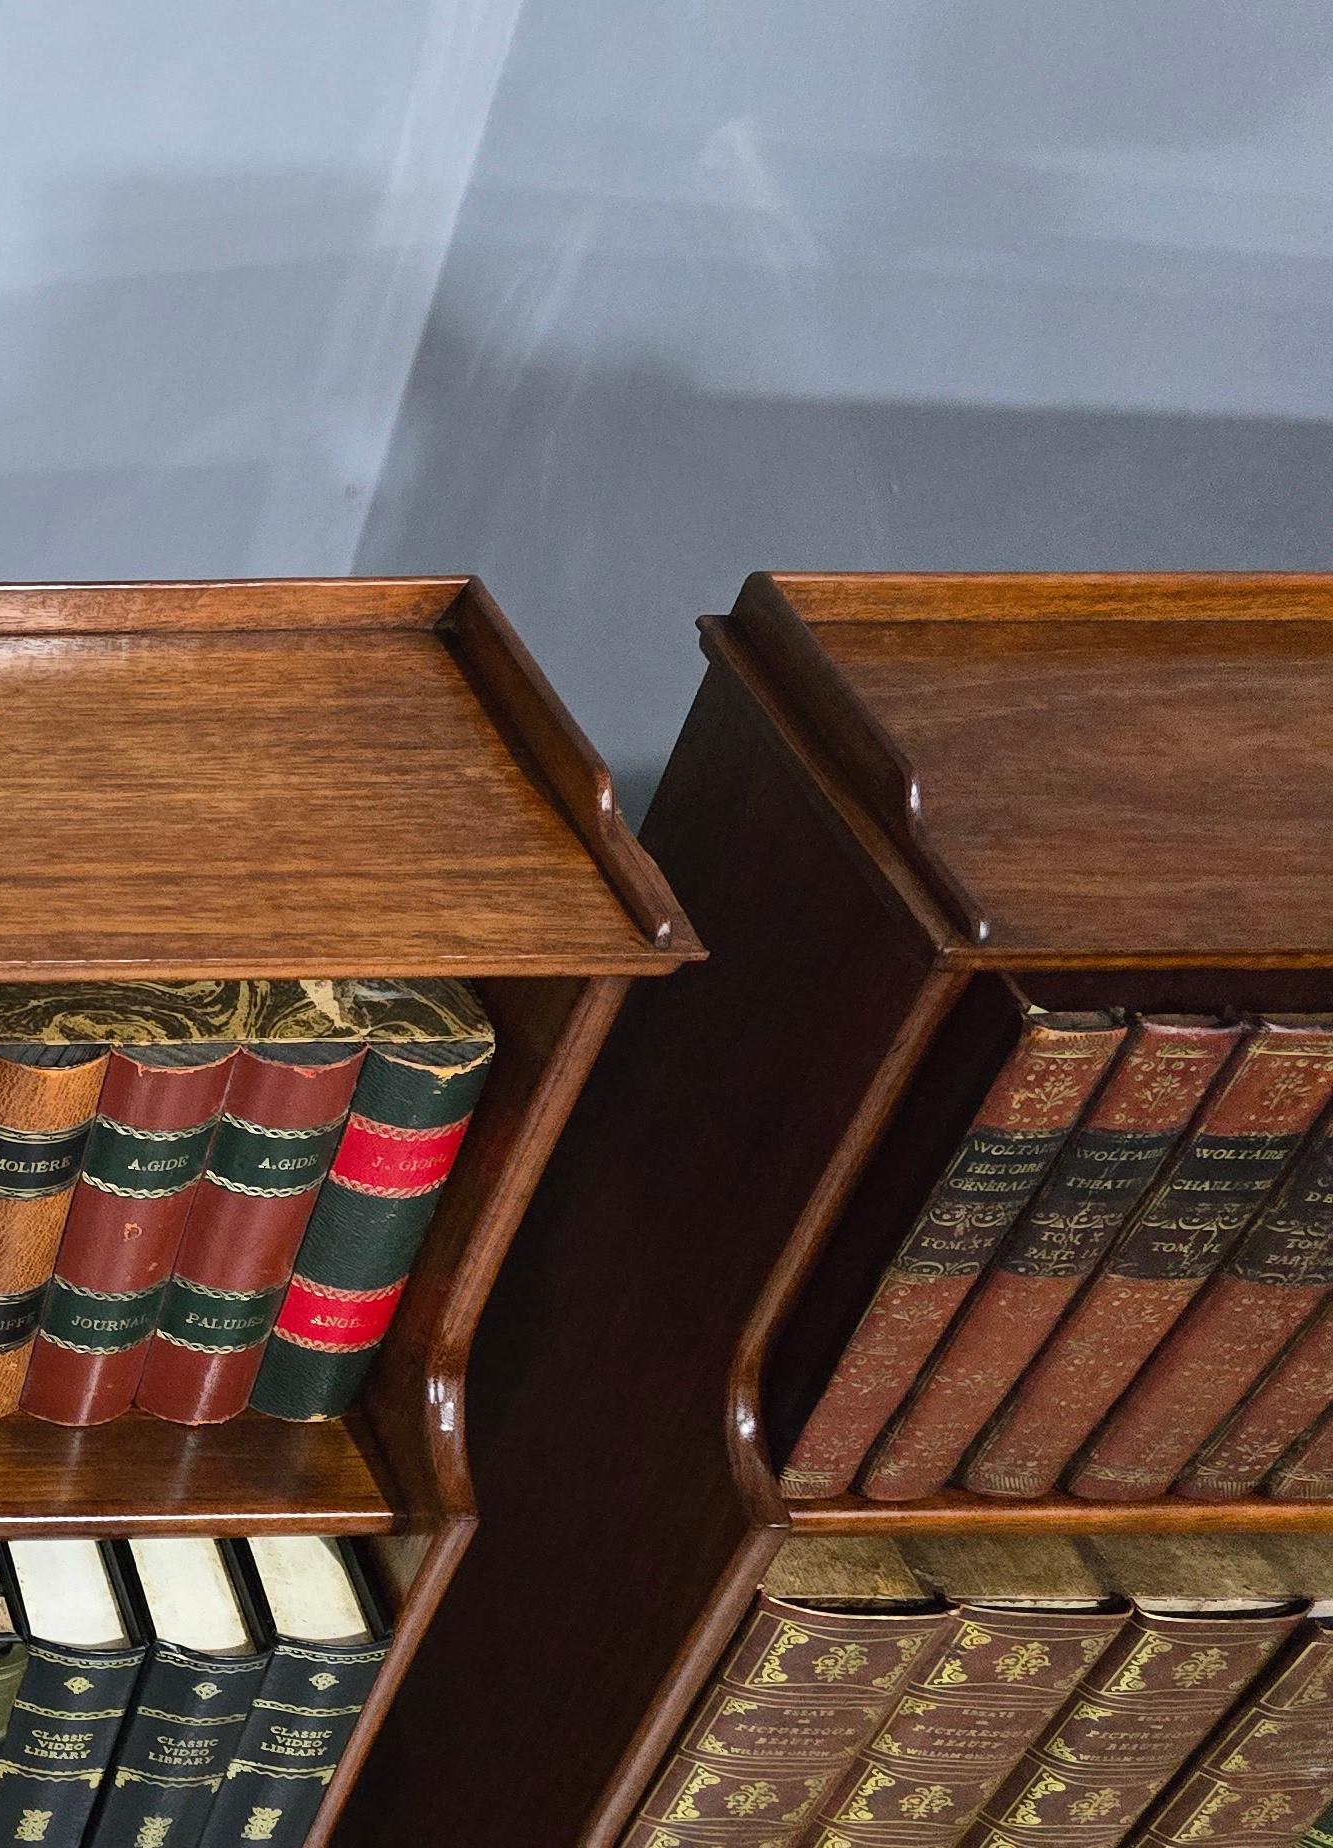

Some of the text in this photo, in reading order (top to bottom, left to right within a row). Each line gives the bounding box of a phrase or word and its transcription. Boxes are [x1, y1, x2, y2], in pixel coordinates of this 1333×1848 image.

[186, 1312, 263, 1330] PALUDES
[31, 1729, 94, 1742] CLASSIC
[270, 1726, 332, 1740] CLASSIC
[734, 1723, 856, 1736] PICTURESQUE
[912, 1724, 1033, 1738] PICTURESQUE
[38, 1739, 86, 1751] VIDEO
[156, 1735, 219, 1749] CLASSIC
[276, 1737, 323, 1748] VIDEO
[23, 1745, 91, 1760] LIBRARY
[163, 1746, 210, 1758] VIDEO
[260, 1741, 328, 1757] LIBRARY
[730, 1746, 784, 1757] WILLIAM
[906, 1747, 961, 1759] WILLIAM
[147, 1751, 215, 1766] LIBRARY
